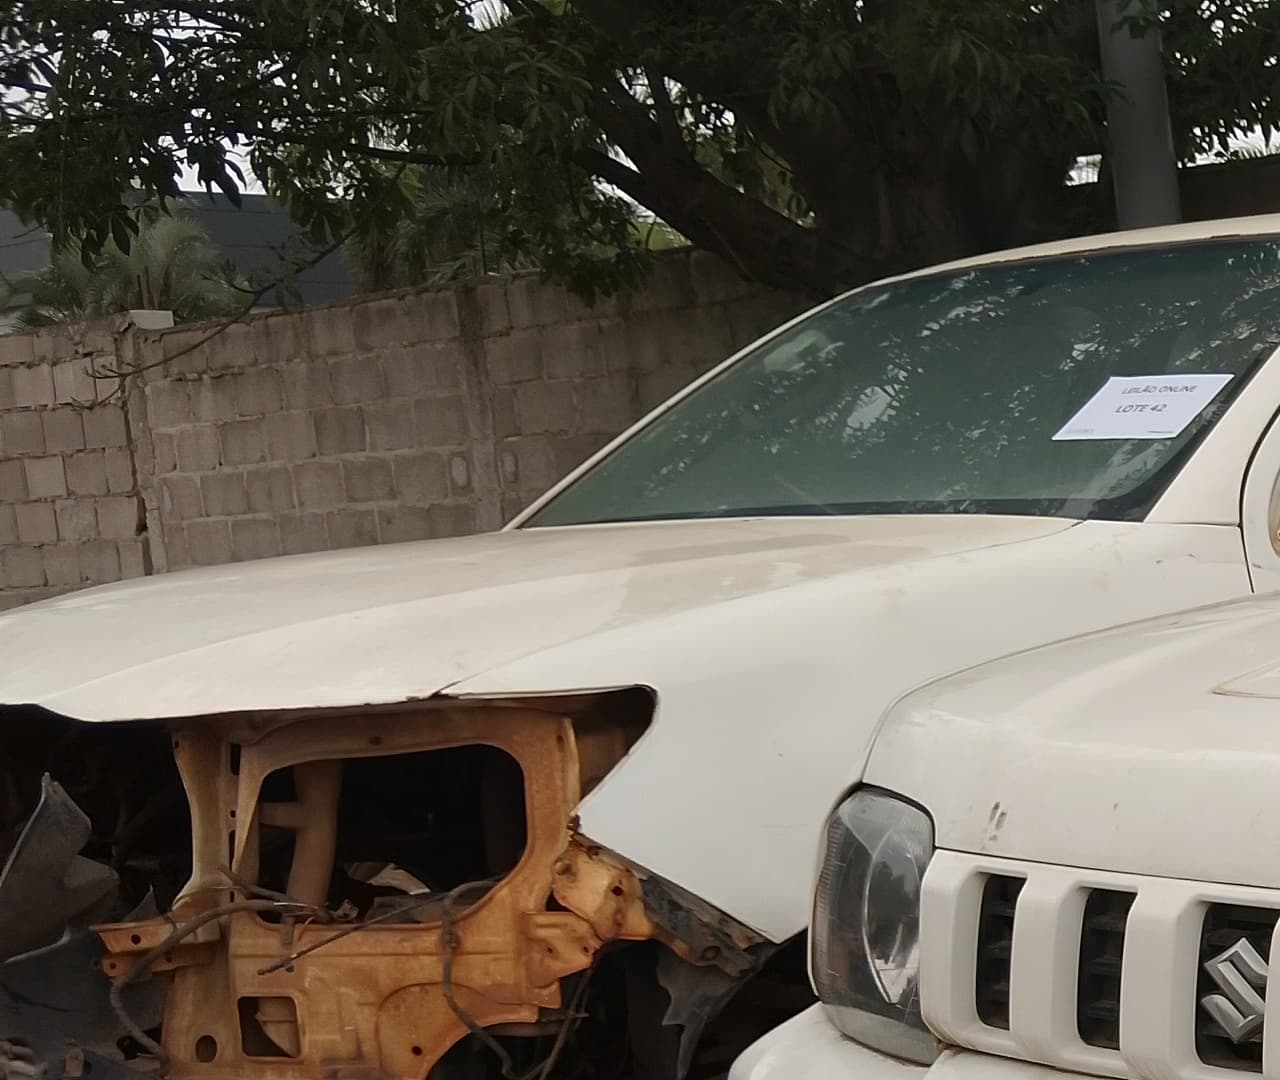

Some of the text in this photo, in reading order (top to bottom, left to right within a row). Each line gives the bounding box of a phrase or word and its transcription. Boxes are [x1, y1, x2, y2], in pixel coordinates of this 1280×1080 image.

[1158, 384, 1198, 394] ONLINE
[1115, 404, 1168, 414] LOTE 42
